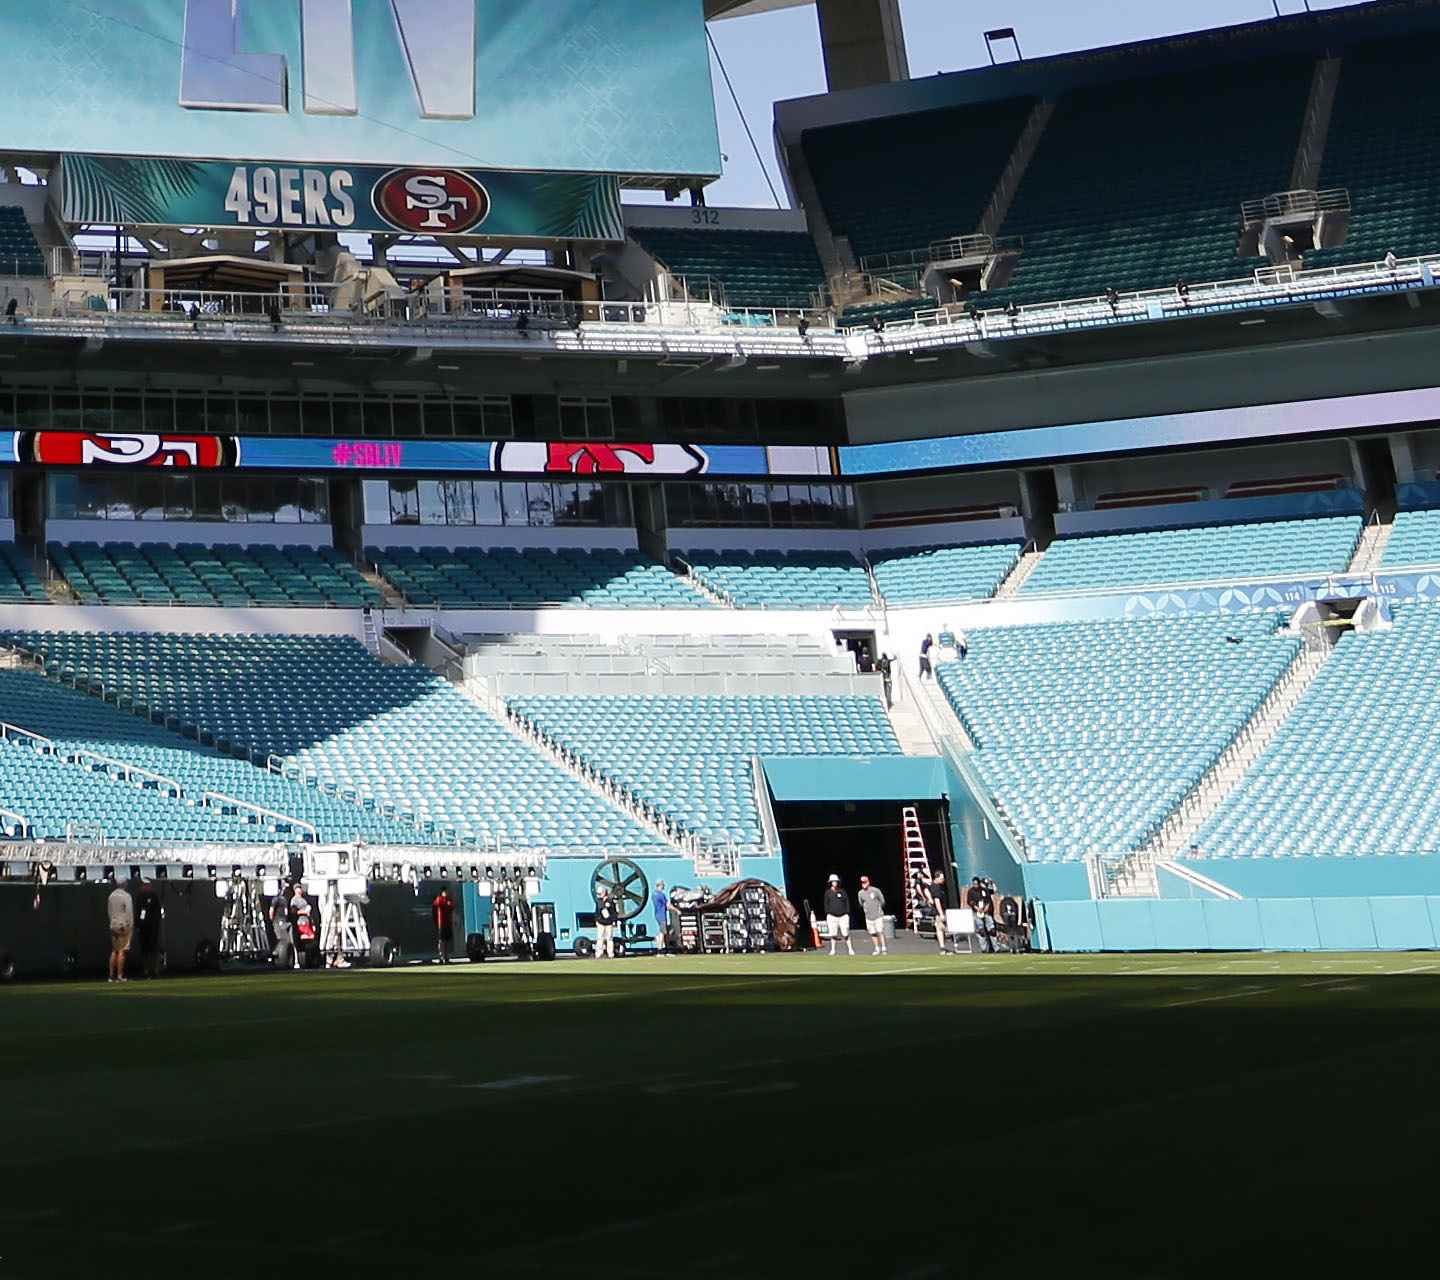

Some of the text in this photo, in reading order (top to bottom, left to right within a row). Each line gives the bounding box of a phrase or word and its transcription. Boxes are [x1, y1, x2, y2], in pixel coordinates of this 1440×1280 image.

[225, 167, 355, 227] 49ERS
[404, 175, 469, 228] SF
[691, 209, 720, 225] 312
